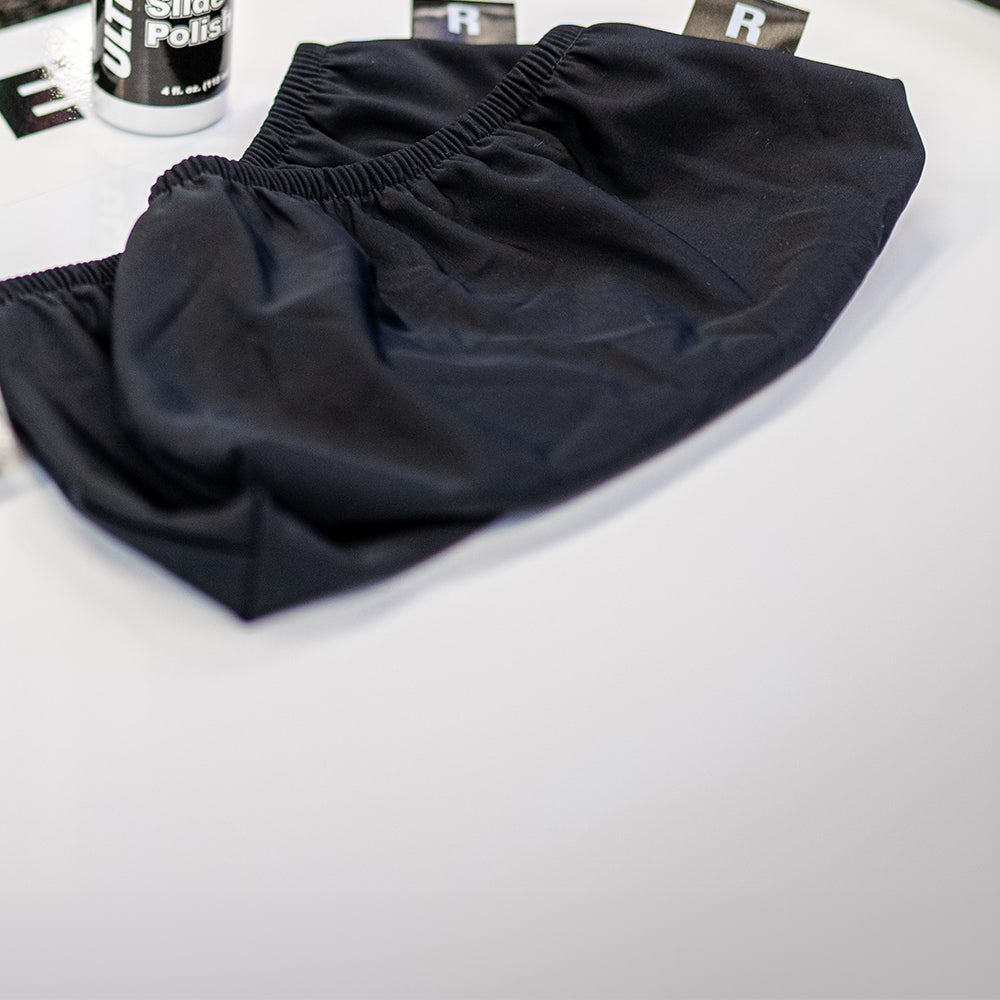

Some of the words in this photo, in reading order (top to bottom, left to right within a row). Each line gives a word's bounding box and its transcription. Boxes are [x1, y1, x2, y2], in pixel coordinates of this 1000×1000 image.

[446, 3, 481, 37] R
[725, 1, 768, 47] R
[160, 85, 170, 97] 4
[185, 83, 202, 95] oz.
